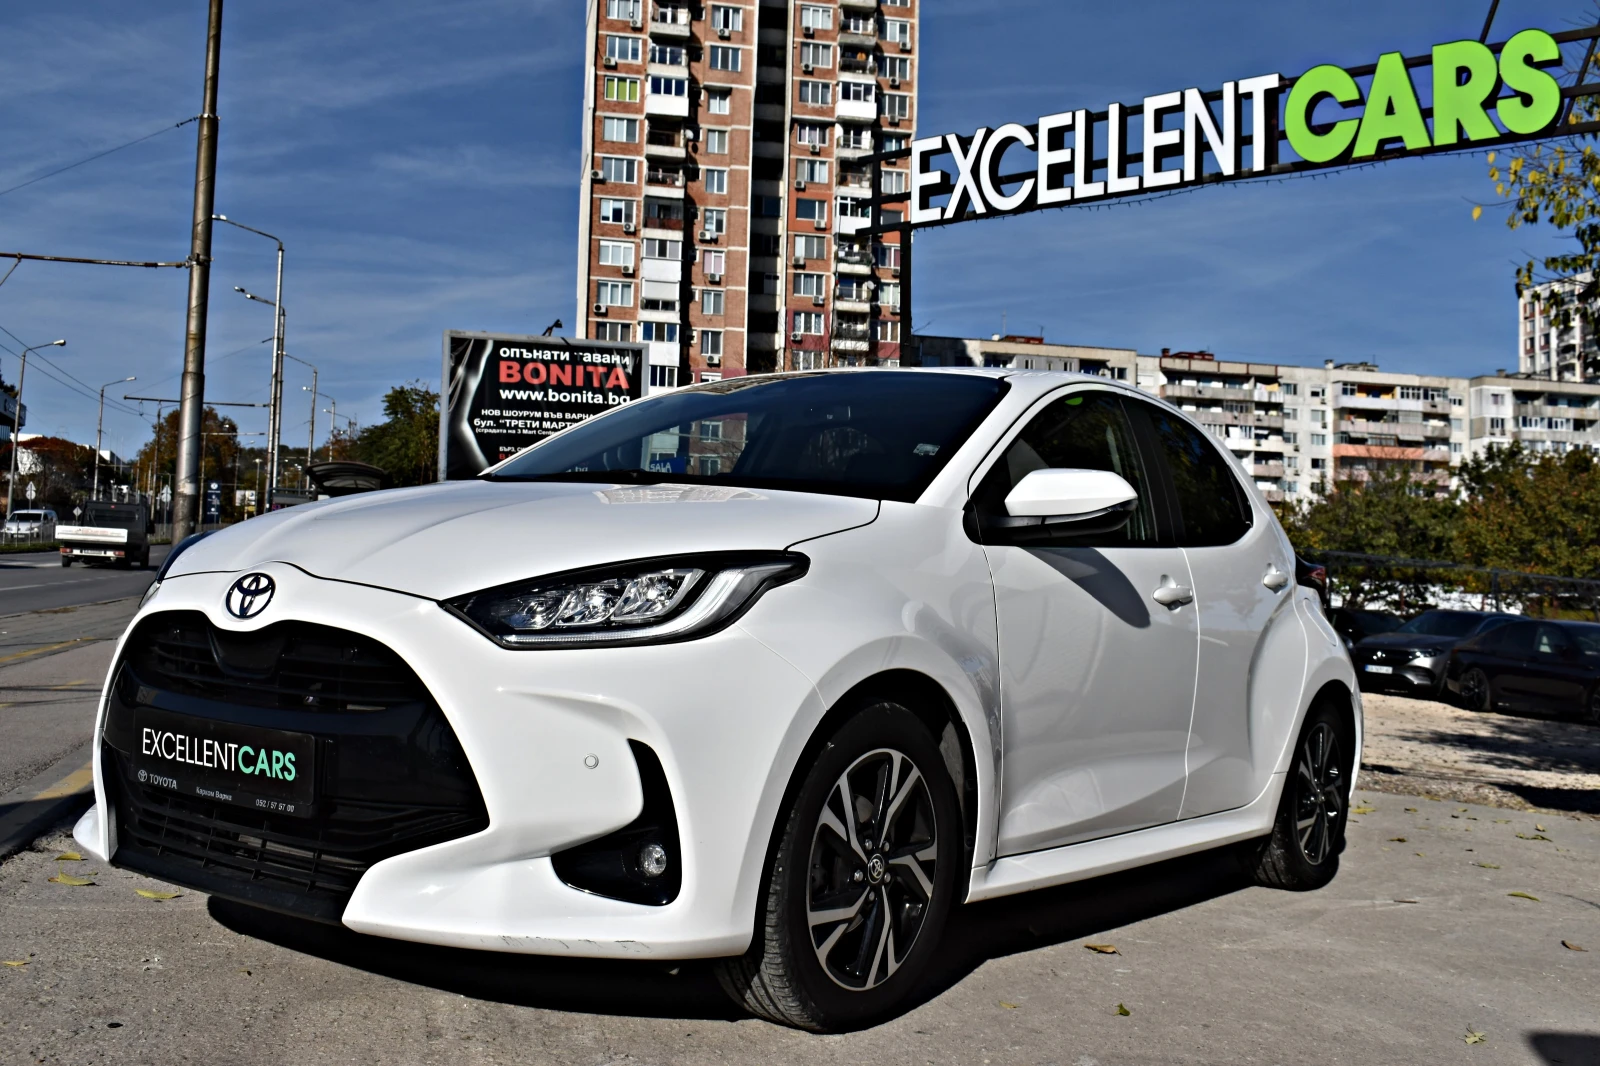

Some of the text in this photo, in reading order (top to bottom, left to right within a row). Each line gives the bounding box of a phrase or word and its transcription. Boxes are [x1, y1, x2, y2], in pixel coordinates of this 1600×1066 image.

[499, 347, 570, 361] опънати
[499, 360, 630, 389] BONITA
[502, 410, 541, 418] ШОУРУМ
[543, 411, 563, 419] ВЪВ
[473, 418, 497, 428] бул.
[150, 774, 177, 789] TOYOTA
[255, 798, 267, 808] 052
[270, 801, 278, 809] 57
[278, 803, 286, 811] 57
[286, 804, 295, 813] 00
